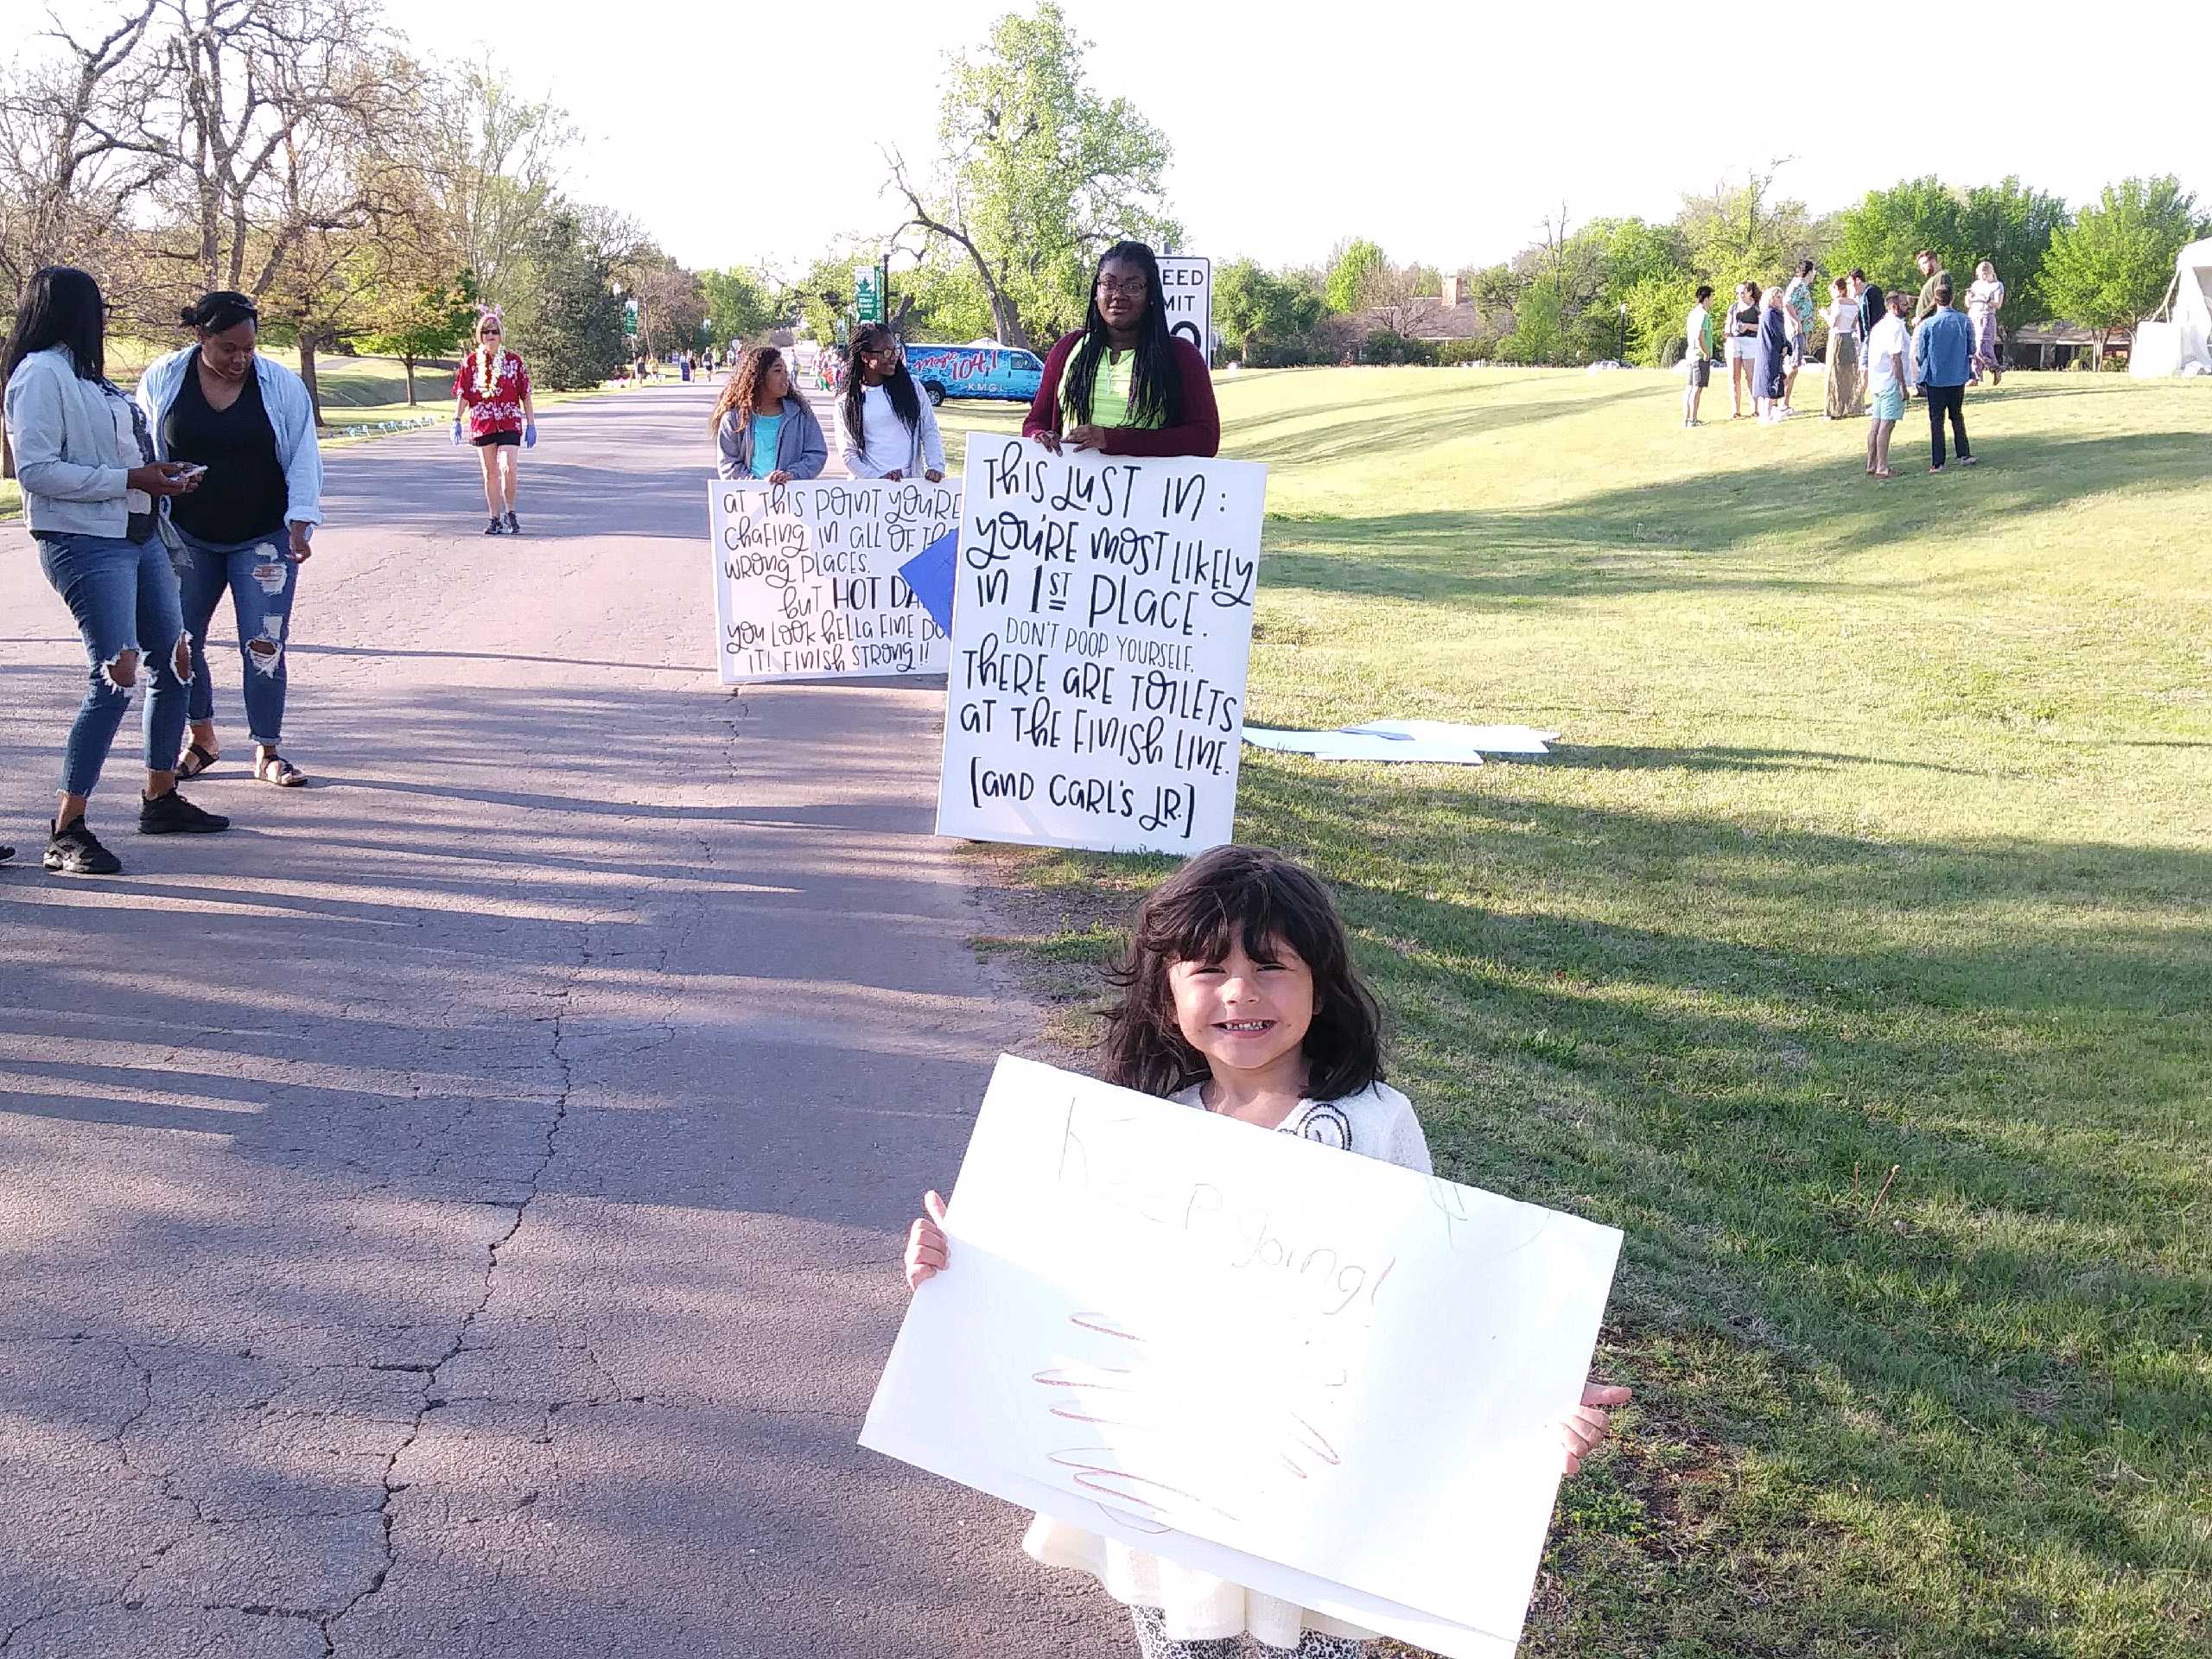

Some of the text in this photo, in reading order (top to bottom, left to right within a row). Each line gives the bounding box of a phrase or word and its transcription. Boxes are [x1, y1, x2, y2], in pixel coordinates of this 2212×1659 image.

[1163, 270, 1204, 286] EED
[1164, 296, 1195, 312] MIT
[833, 577, 881, 609] HOT
[1007, 618, 1194, 673] DON'T POOP YOURSELF.
